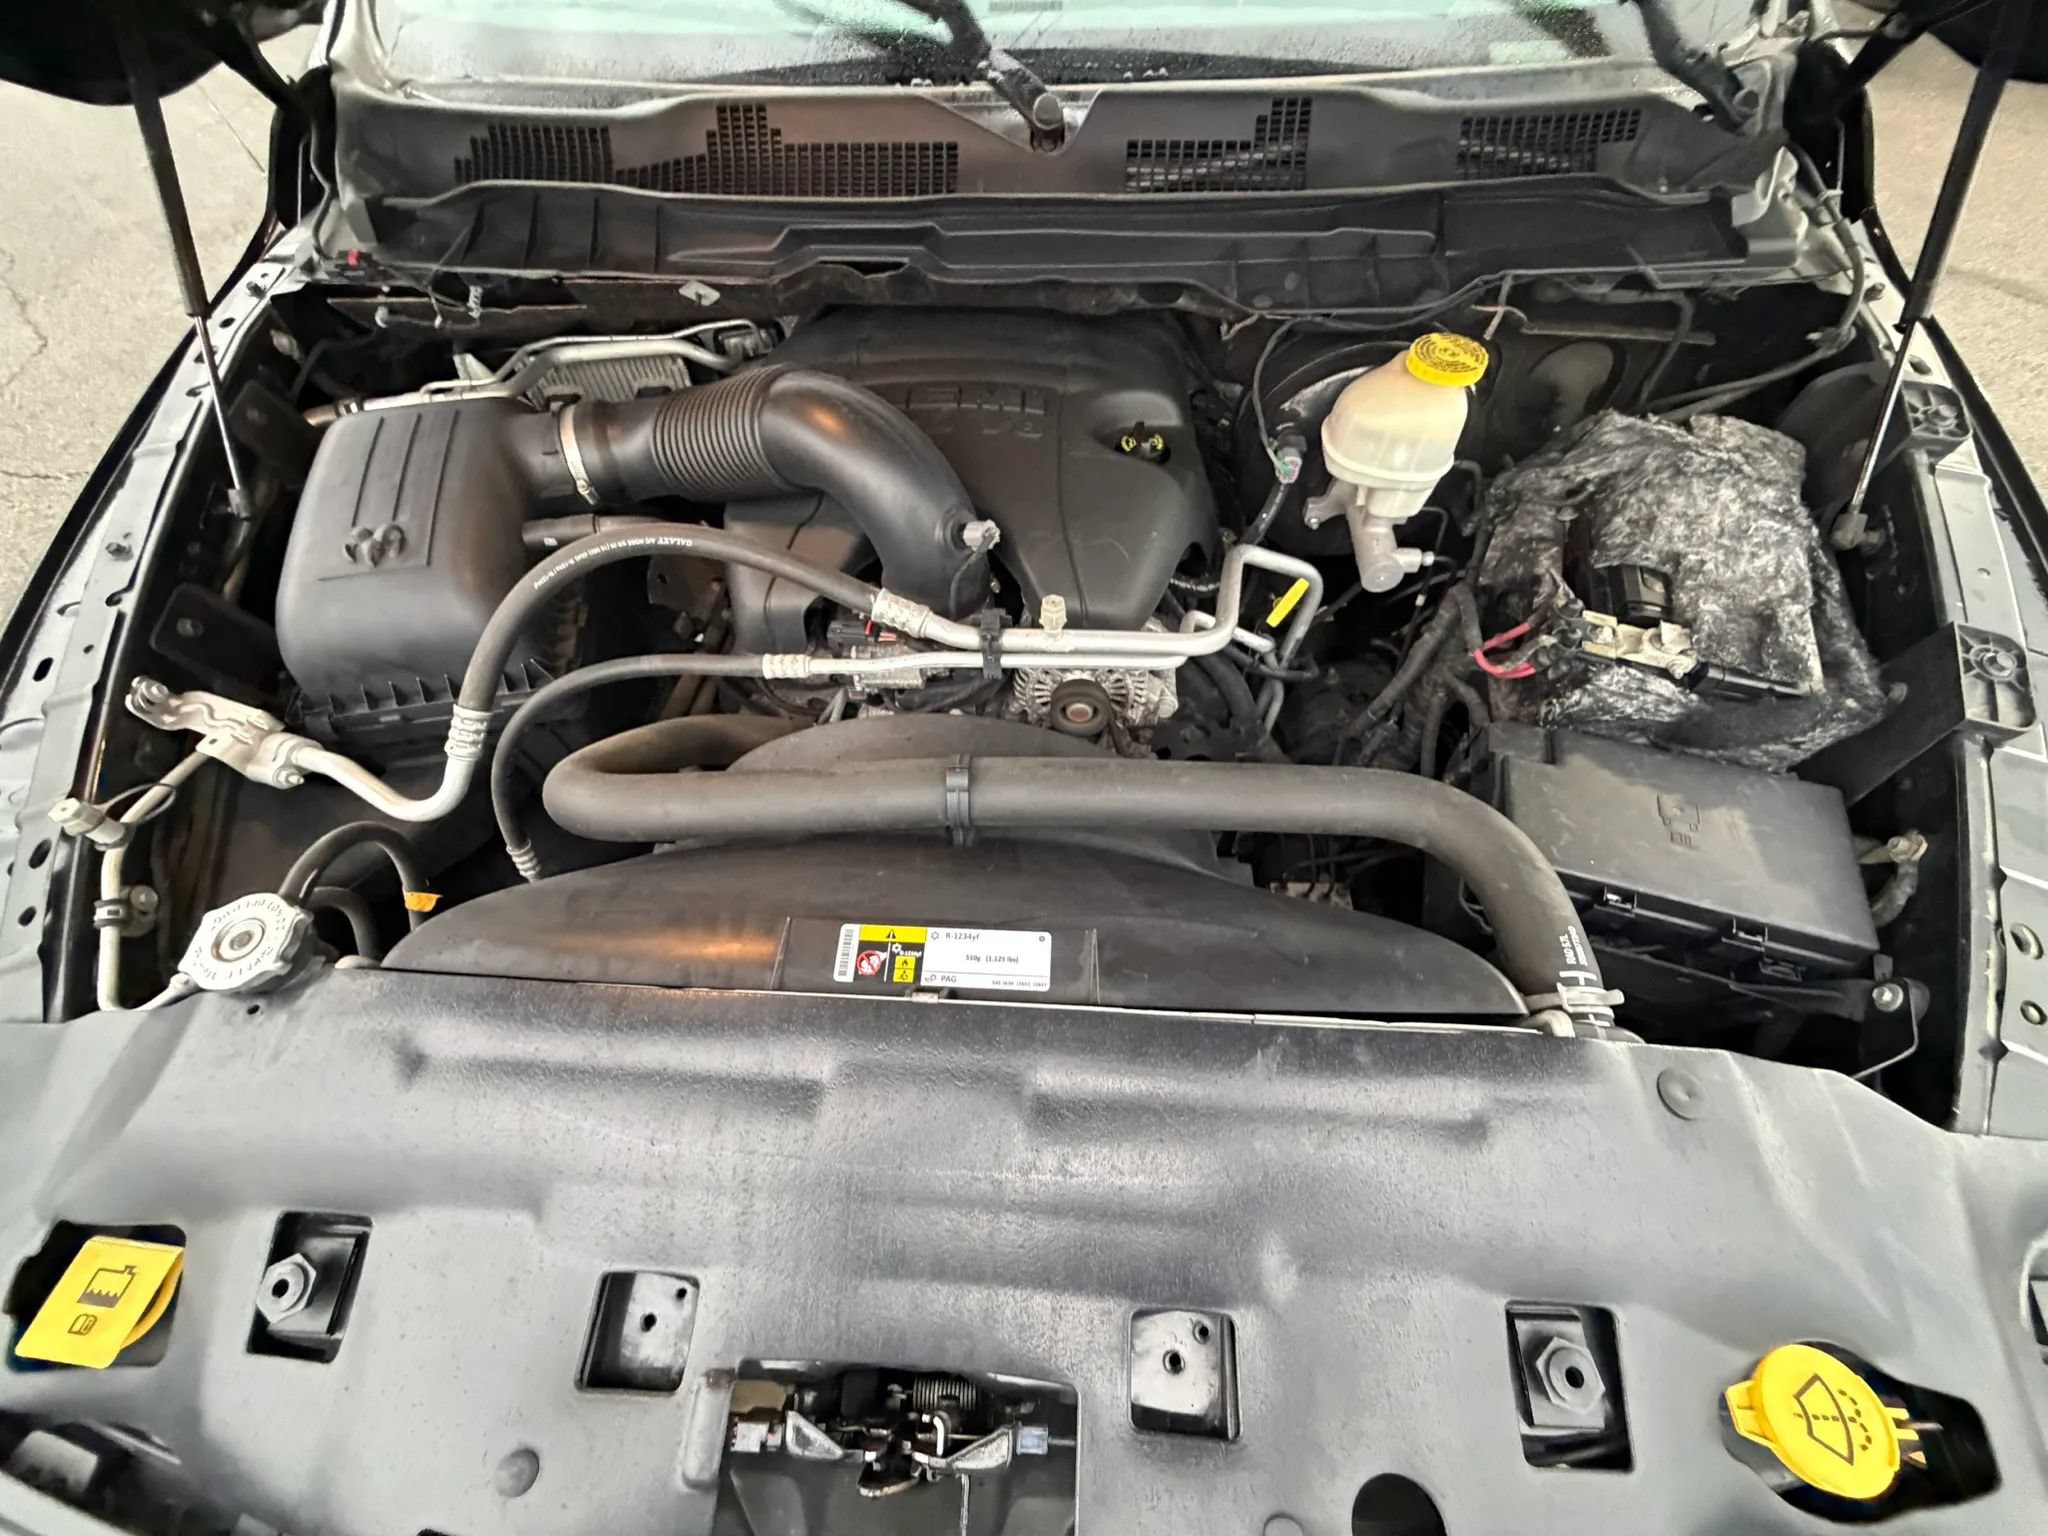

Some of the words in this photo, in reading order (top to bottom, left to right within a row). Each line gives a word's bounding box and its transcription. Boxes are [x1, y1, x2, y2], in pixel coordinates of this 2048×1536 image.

[657, 536, 693, 547] GALAXY
[945, 932, 980, 942] R-1234yf
[965, 953, 981, 963] 510g
[940, 974, 957, 983] PAG
